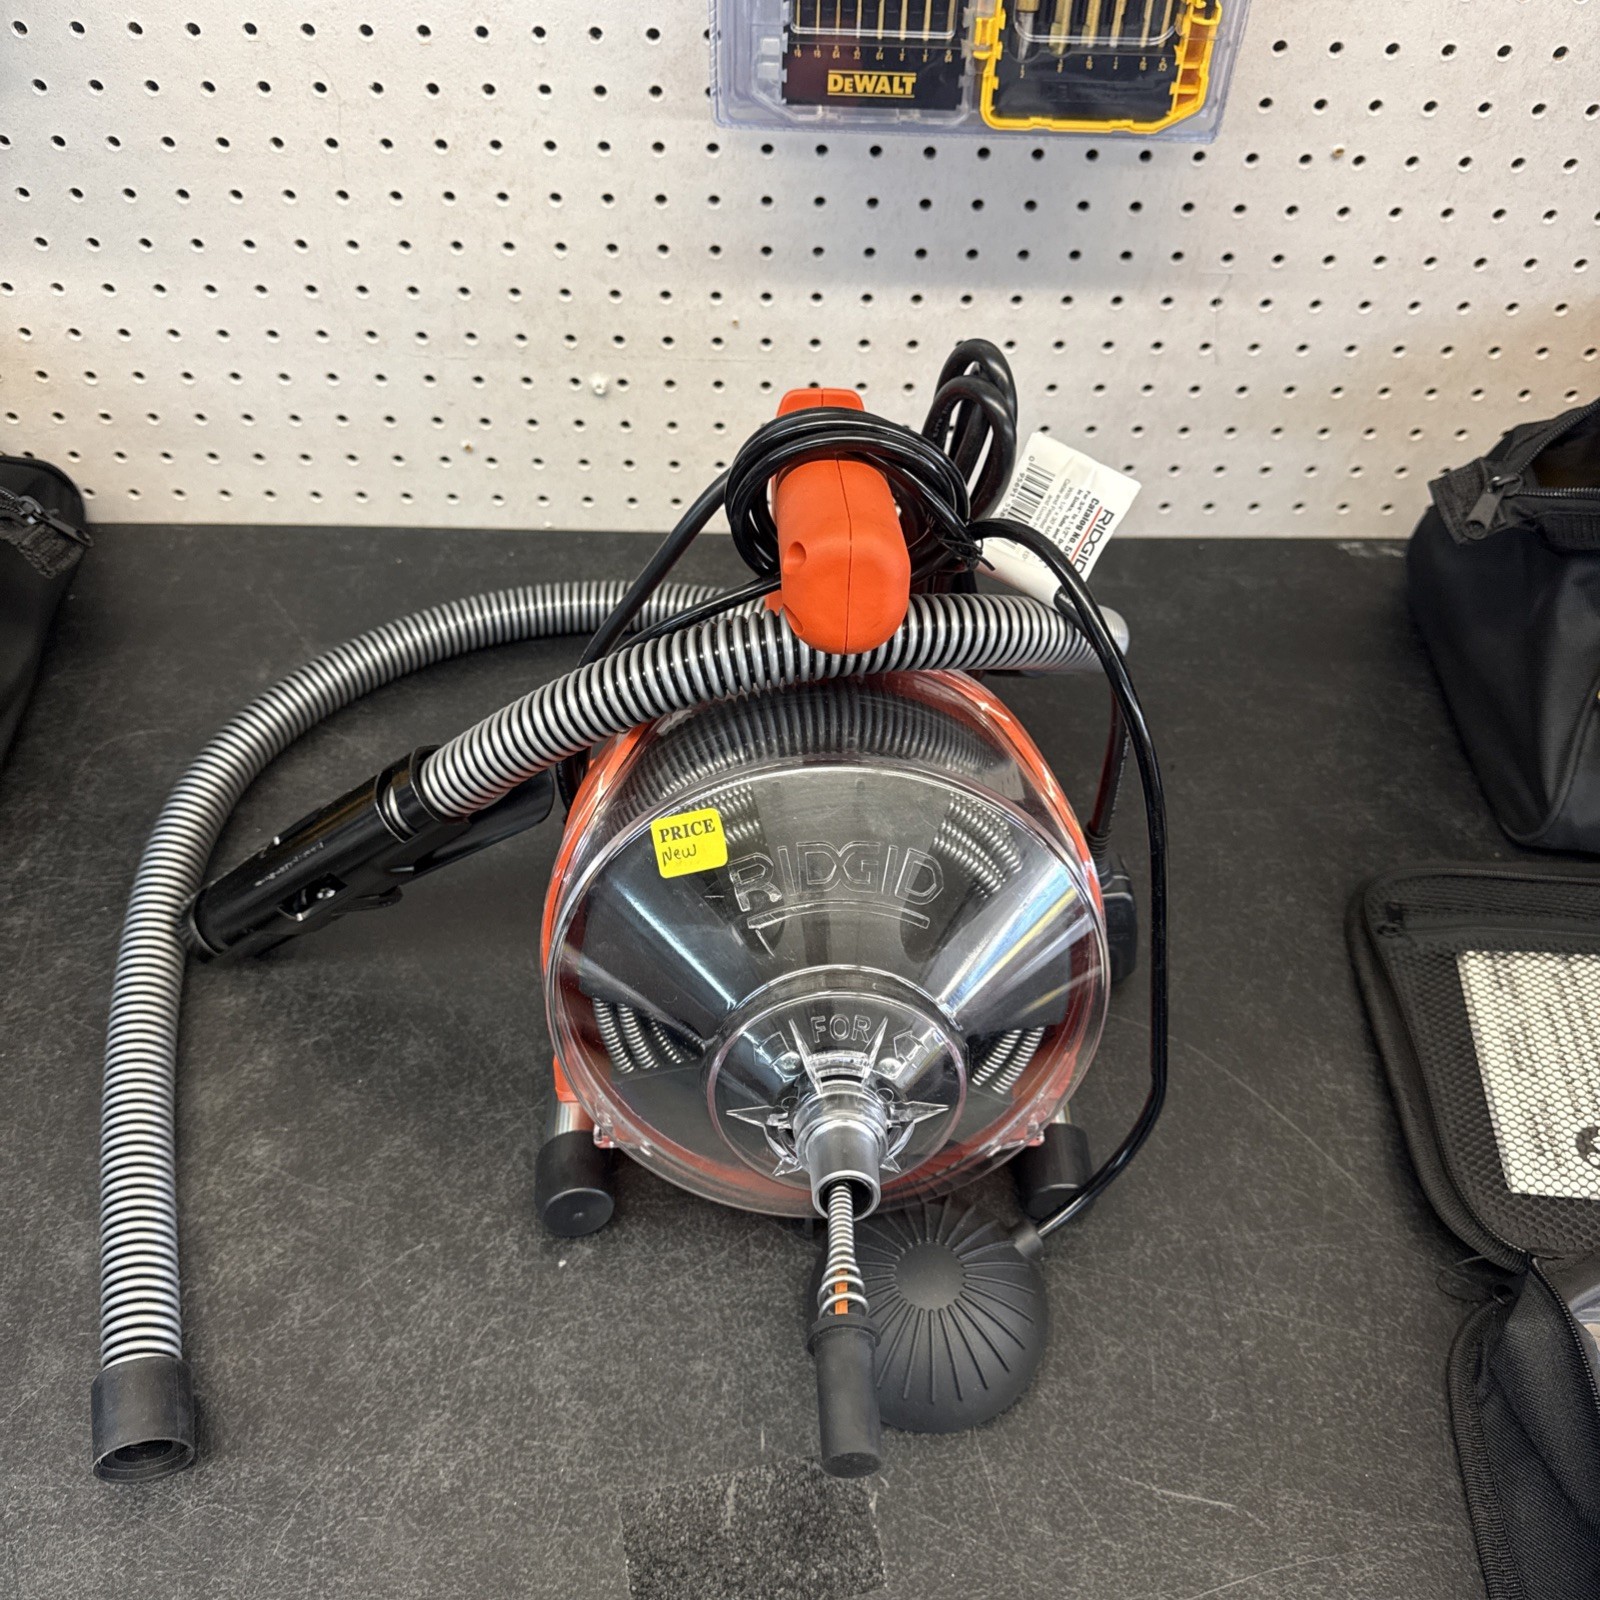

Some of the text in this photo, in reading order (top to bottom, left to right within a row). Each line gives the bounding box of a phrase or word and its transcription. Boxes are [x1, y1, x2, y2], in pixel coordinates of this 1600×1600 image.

[827, 73, 917, 95] DEWALT
[1076, 498, 1099, 531] Catalog
[1068, 532, 1080, 545] No.
[1074, 509, 1115, 574] RIDGID
[659, 818, 716, 843] PRICE
[662, 843, 697, 867] New
[727, 840, 944, 912] RIDGID
[810, 1013, 872, 1043] FOR
